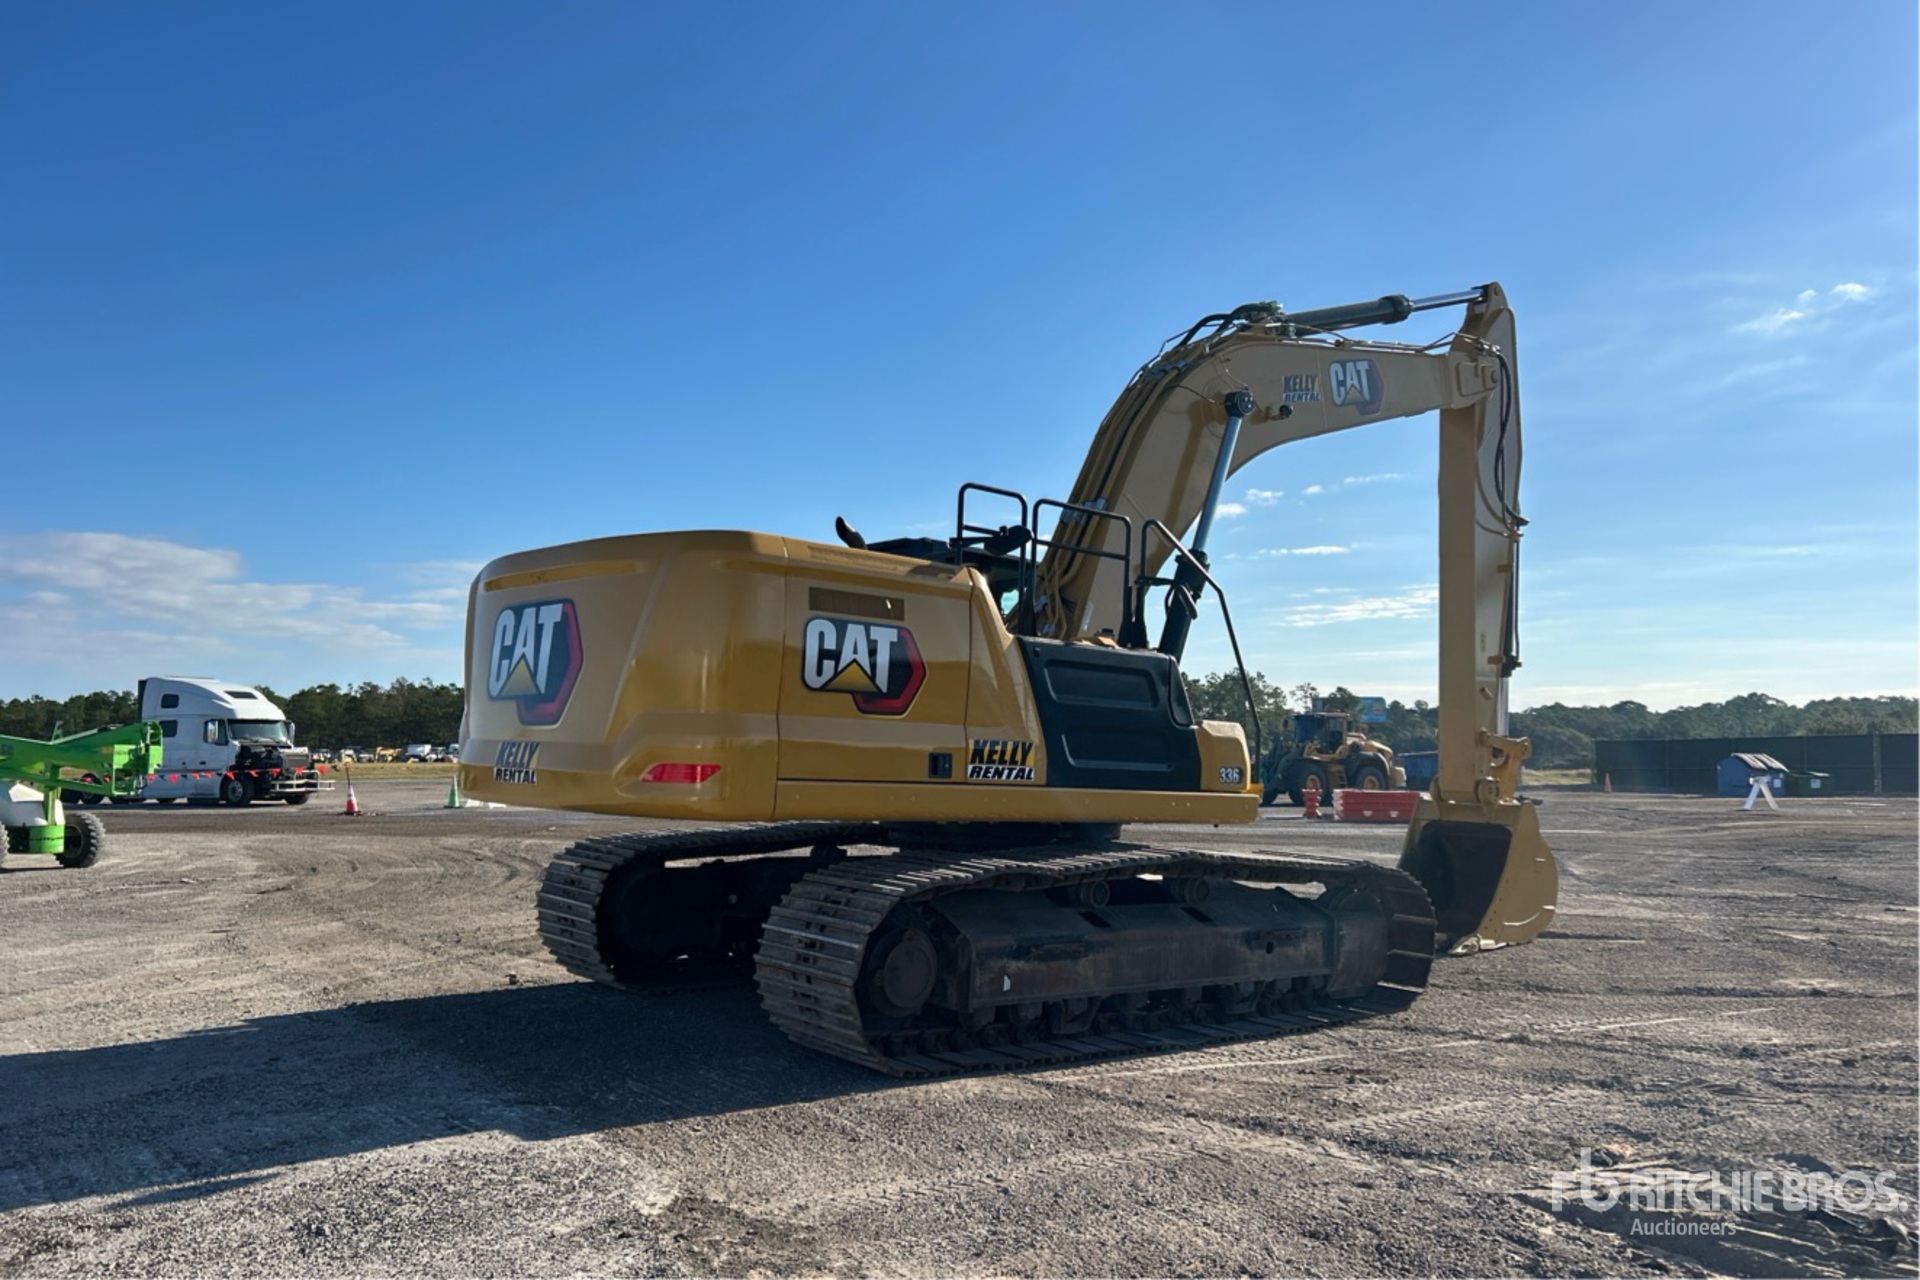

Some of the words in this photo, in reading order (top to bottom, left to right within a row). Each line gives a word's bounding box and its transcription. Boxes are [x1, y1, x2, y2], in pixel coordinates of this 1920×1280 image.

[1284, 375, 1317, 392] KELLY
[1330, 361, 1369, 405] CAT
[1285, 393, 1320, 402] RENTAL
[489, 603, 563, 697] CAT
[804, 618, 897, 693] CAT
[495, 741, 540, 767] KELLY
[970, 740, 1033, 765] KELLY
[496, 768, 535, 784] RENTAL
[968, 765, 1034, 780] RENTAL
[1219, 767, 1239, 783] 336
